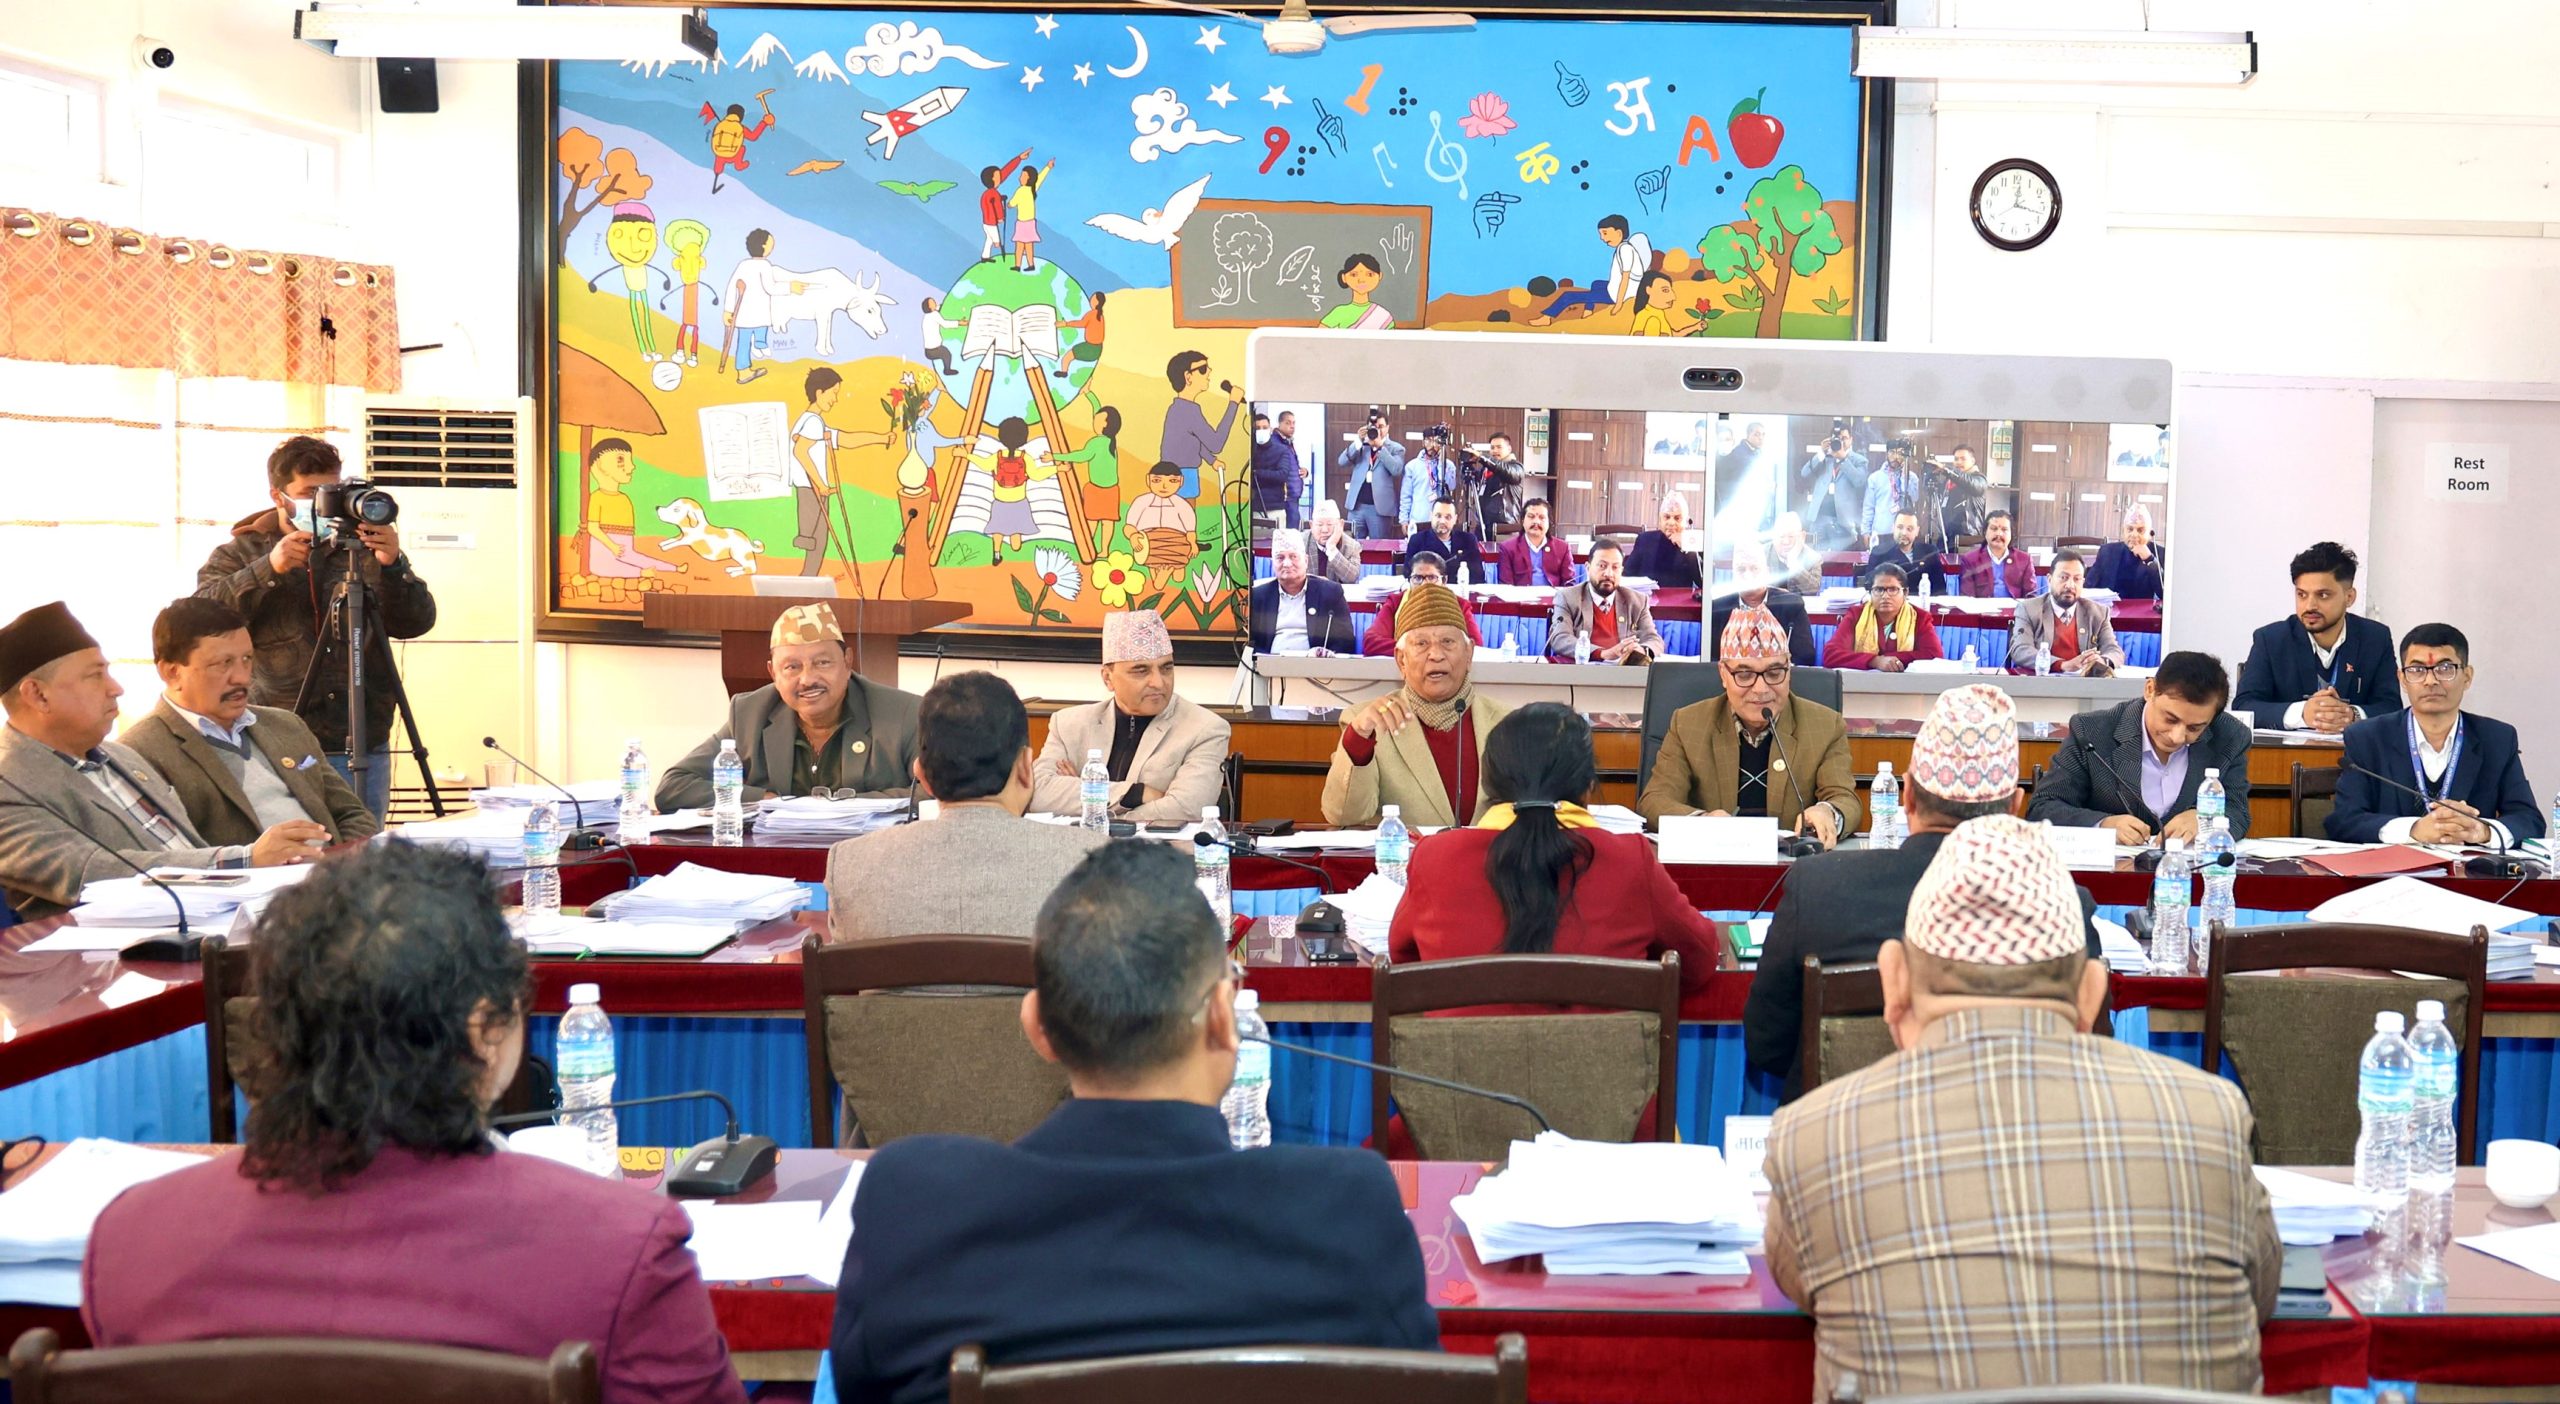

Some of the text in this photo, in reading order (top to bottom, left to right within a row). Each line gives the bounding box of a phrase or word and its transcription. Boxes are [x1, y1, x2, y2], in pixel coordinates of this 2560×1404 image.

[1344, 63, 1384, 116] 1
[1604, 76, 1656, 137] अ
[1677, 115, 1721, 167] A
[1514, 141, 1560, 185] क
[2001, 177, 2008, 187] 11
[2013, 174, 2022, 185] 12
[1990, 186, 1999, 197] 10
[2454, 456, 2486, 470] Rest
[2448, 478, 2490, 491] Room
